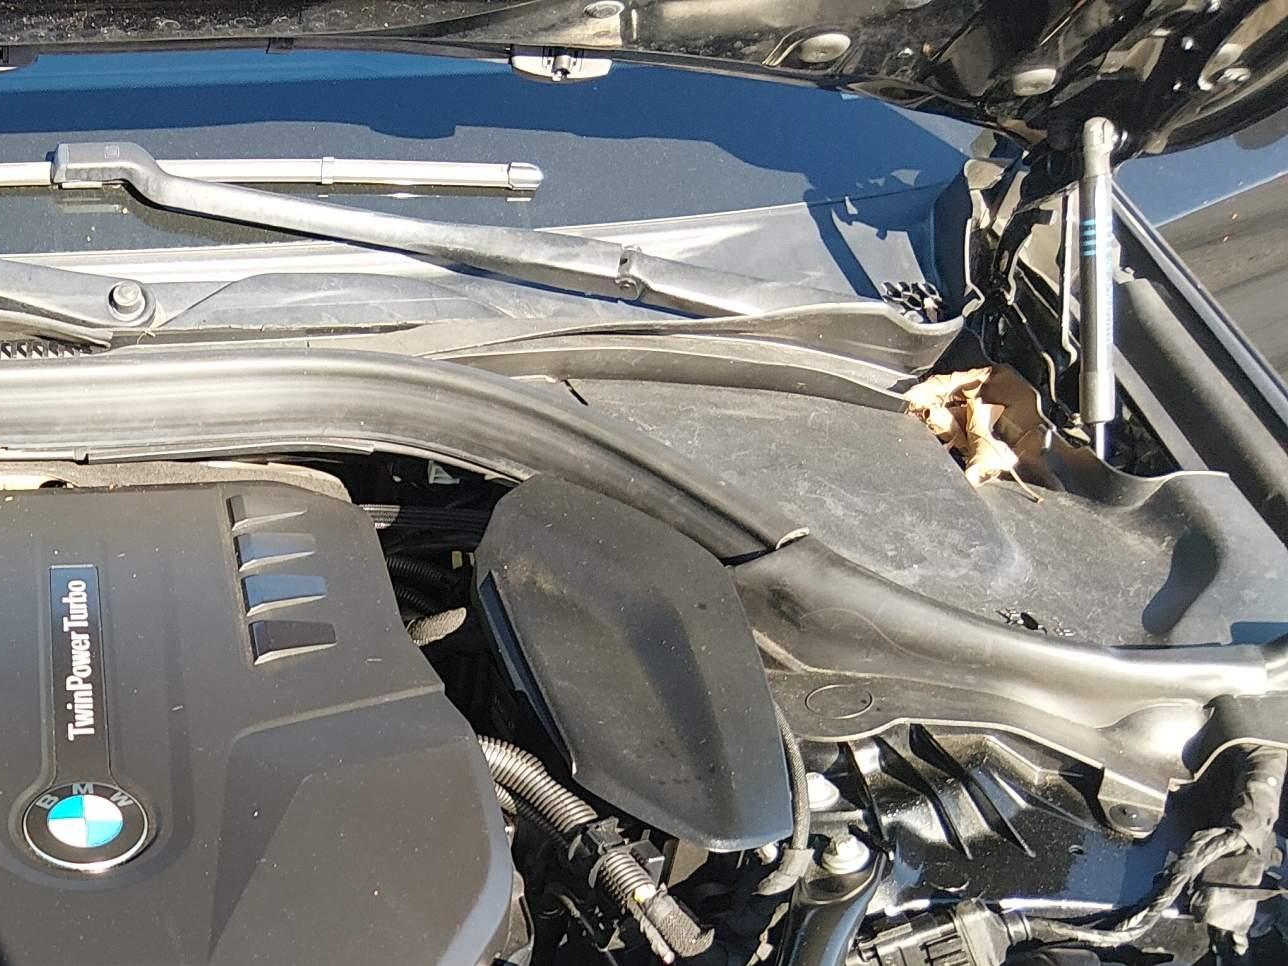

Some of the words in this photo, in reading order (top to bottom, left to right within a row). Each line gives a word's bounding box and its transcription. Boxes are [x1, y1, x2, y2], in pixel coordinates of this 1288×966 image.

[61, 579, 90, 632] Turbo
[65, 630, 95, 742] TwinPower
[36, 782, 134, 811] BMW
